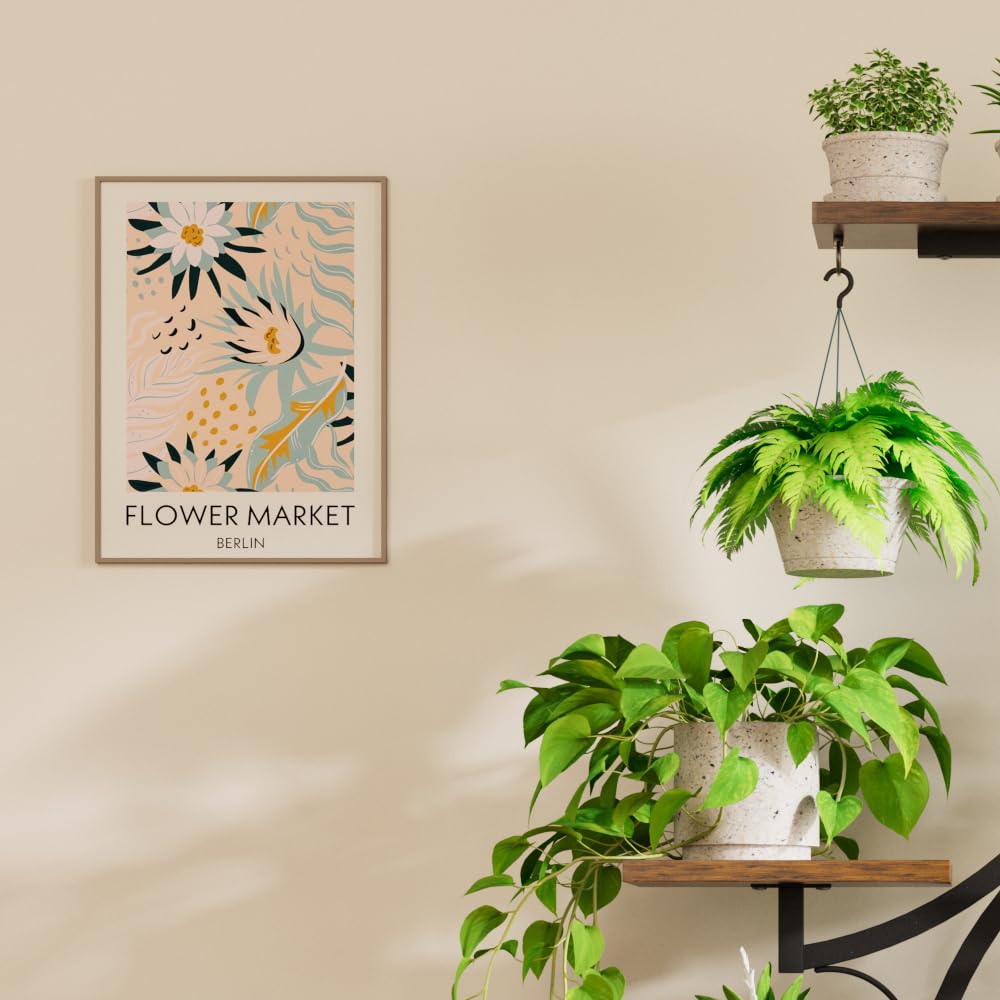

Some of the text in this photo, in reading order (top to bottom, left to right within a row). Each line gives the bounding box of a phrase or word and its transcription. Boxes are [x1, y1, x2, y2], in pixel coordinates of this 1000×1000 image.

[125, 504, 356, 527] FLOWER MARKET
[216, 537, 265, 549] BERLIN
